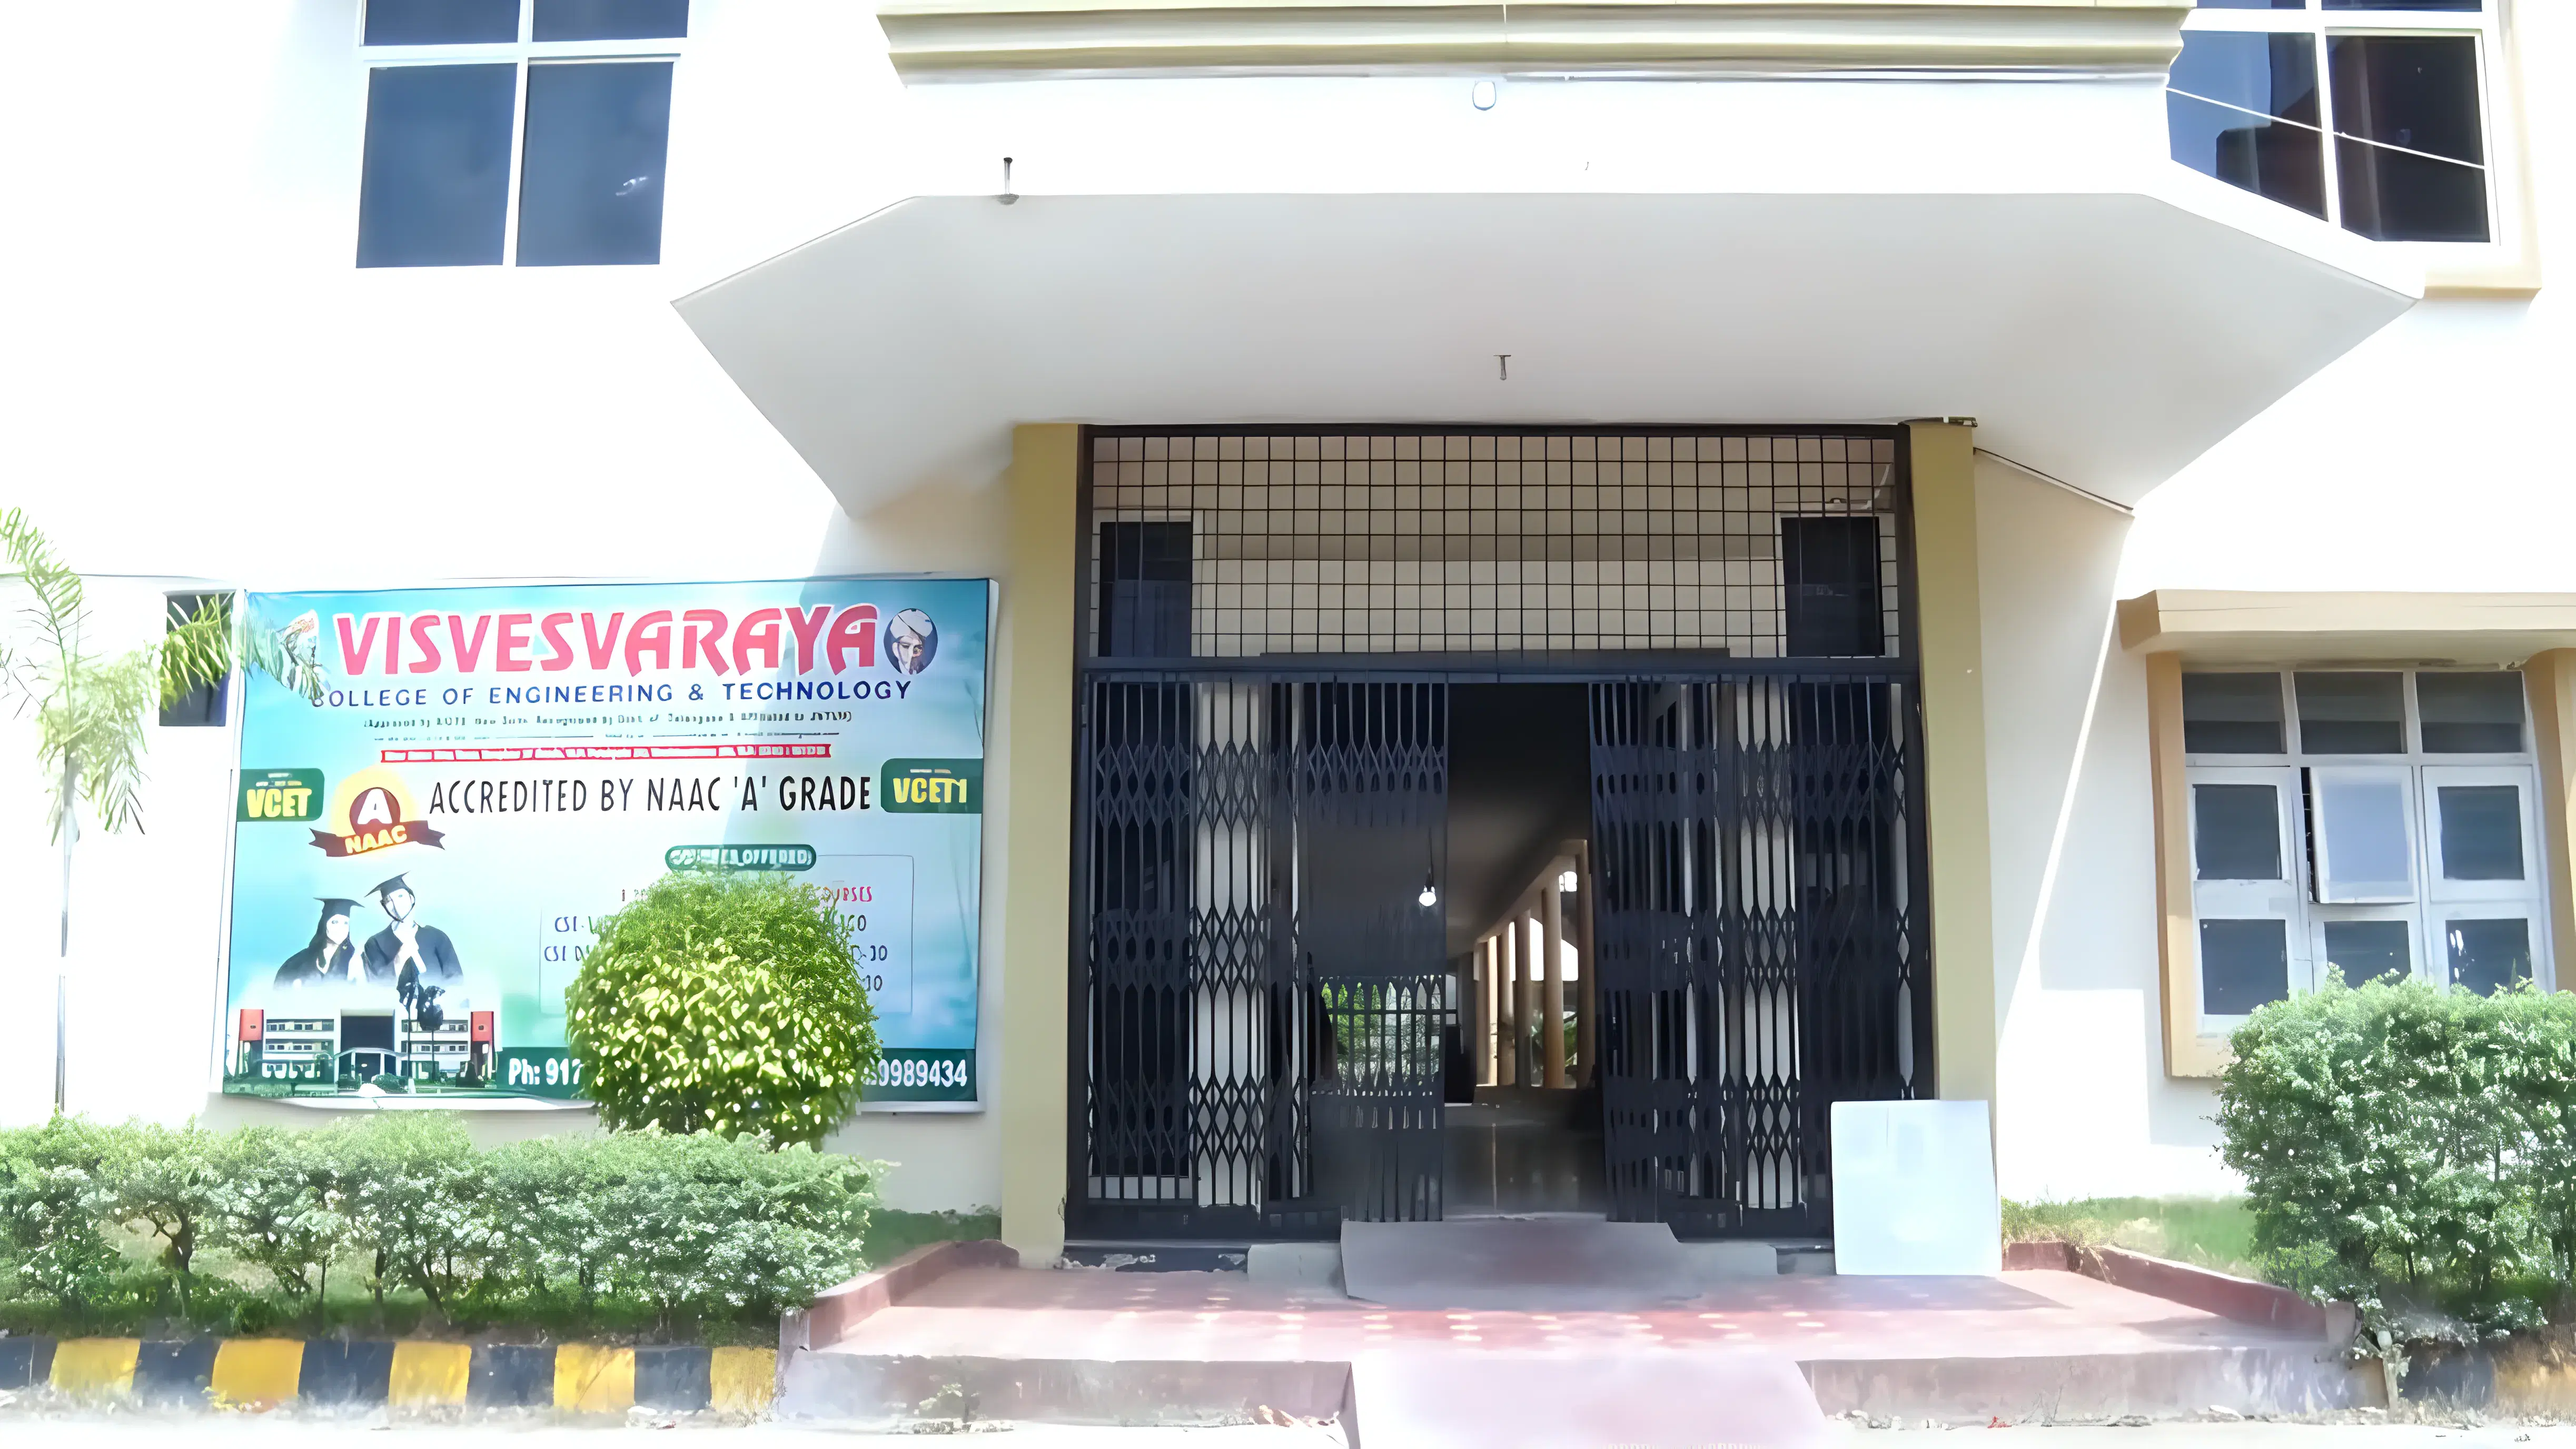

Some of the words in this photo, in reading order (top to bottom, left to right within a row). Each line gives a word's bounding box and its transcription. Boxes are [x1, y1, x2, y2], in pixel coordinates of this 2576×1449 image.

[337, 603, 878, 677] VISVESVARAYA
[443, 688, 473, 705] OF
[490, 683, 672, 704] ENGINEERING
[688, 683, 704, 701] &
[722, 680, 911, 701] TECHNOLOGY
[246, 788, 312, 818] VCET
[357, 788, 393, 825] A
[429, 780, 587, 813] ACCREDITED
[601, 778, 633, 811] BY
[647, 777, 720, 811] NAAC
[734, 776, 766, 811] 'A'
[779, 776, 870, 811] GRADE
[344, 825, 408, 854] NAAC
[508, 1057, 540, 1086] Ph:
[865, 1058, 968, 1088] 9989434
